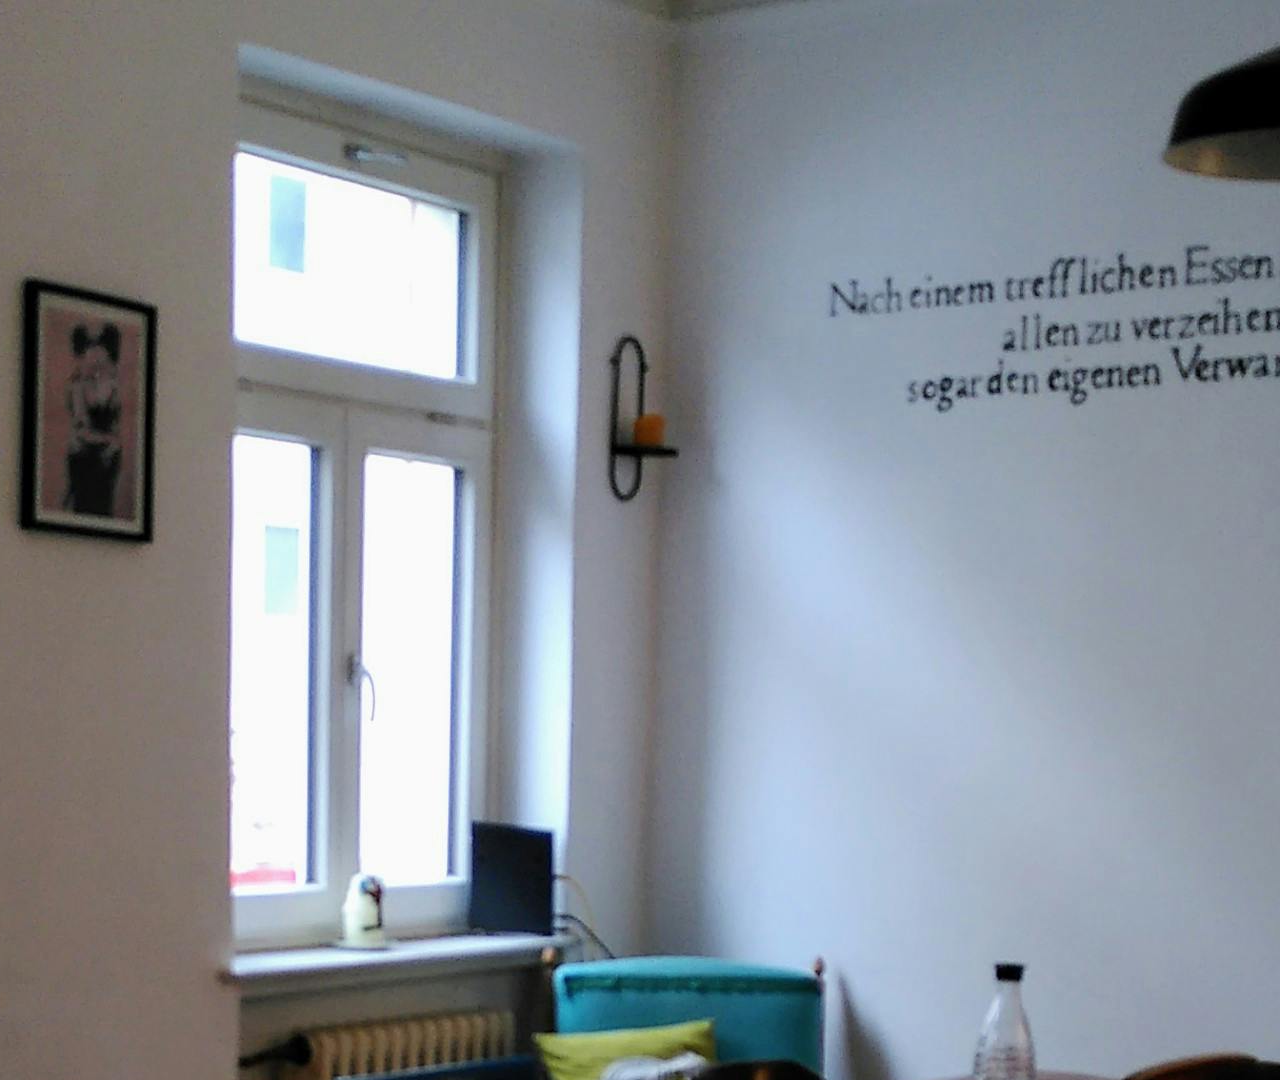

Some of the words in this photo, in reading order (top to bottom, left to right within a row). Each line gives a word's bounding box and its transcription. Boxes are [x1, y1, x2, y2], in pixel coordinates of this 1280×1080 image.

[829, 274, 904, 318] Nach
[909, 273, 995, 309] einem
[1005, 252, 1177, 300] trefflichen
[1185, 244, 1275, 286] Essen
[1001, 312, 1080, 352] allen
[1086, 318, 1122, 346] zu
[906, 370, 982, 413] sogar
[985, 356, 1039, 396] den
[1047, 355, 1161, 406] eigenen
